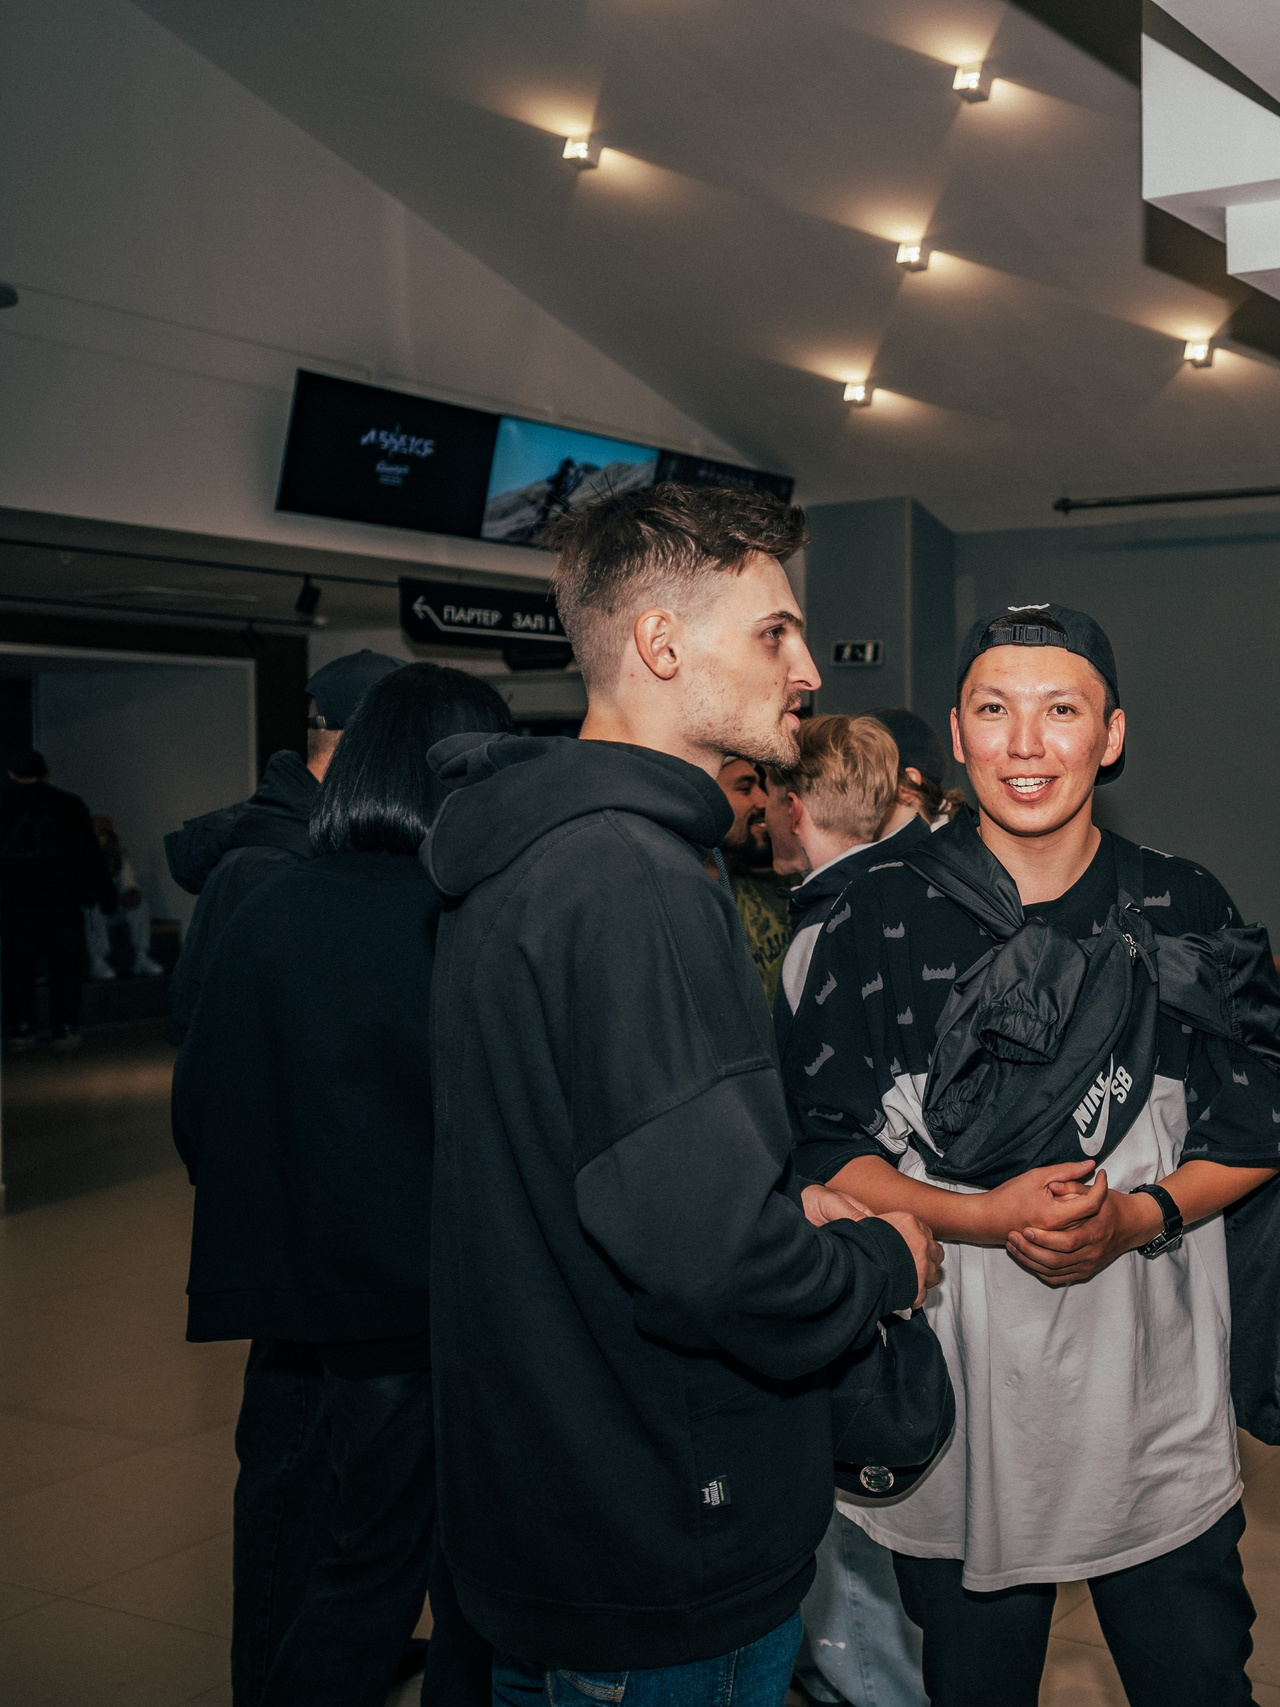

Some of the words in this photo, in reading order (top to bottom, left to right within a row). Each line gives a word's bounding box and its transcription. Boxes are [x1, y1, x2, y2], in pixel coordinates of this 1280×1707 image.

[443, 605, 503, 627] ПАРТЕР
[512, 611, 546, 632] ЗАЛ
[1110, 1065, 1133, 1104] SB
[709, 1480, 721, 1506] GORILLA
